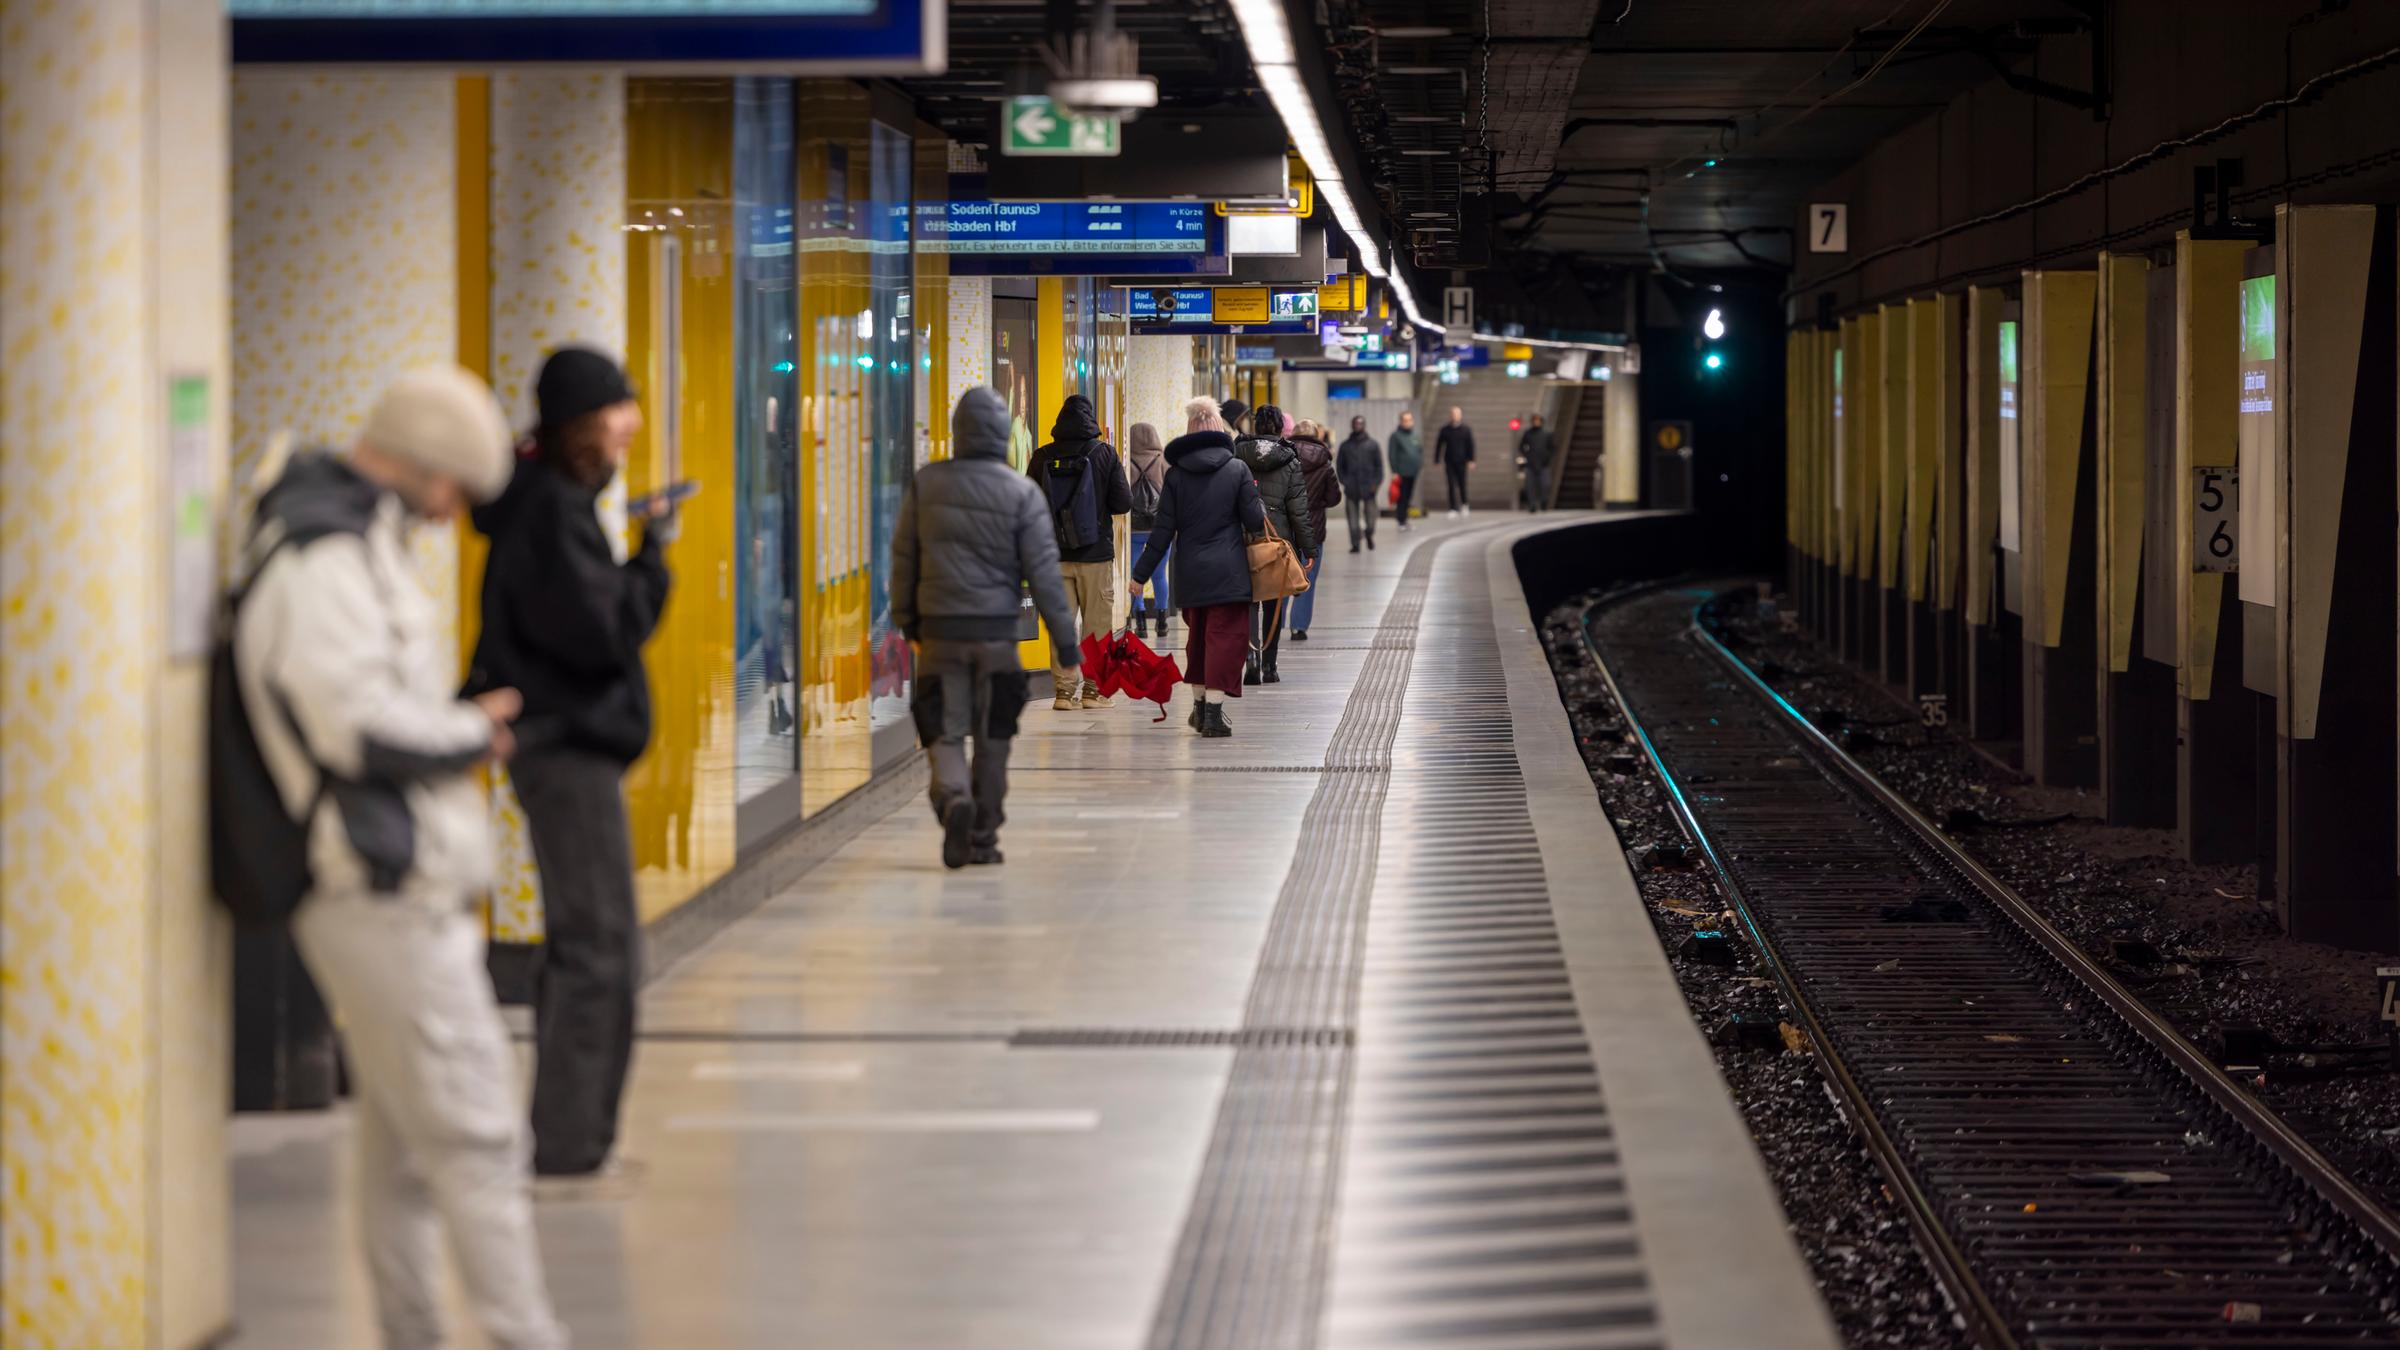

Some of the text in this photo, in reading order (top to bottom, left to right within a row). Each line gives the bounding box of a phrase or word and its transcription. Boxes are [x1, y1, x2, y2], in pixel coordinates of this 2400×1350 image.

[951, 203, 1040, 216] Soden(Taunus)
[1169, 208, 1178, 216] in
[1179, 208, 1203, 216] Kürze
[947, 219, 1203, 232] sbaden Hbf 4 min
[1820, 210, 1836, 245] 7
[1134, 291, 1150, 300] Bad
[1448, 290, 1469, 325] H
[1704, 308, 1724, 339] 6
[2208, 519, 2234, 558] 6
[1921, 701, 1948, 728] 35
